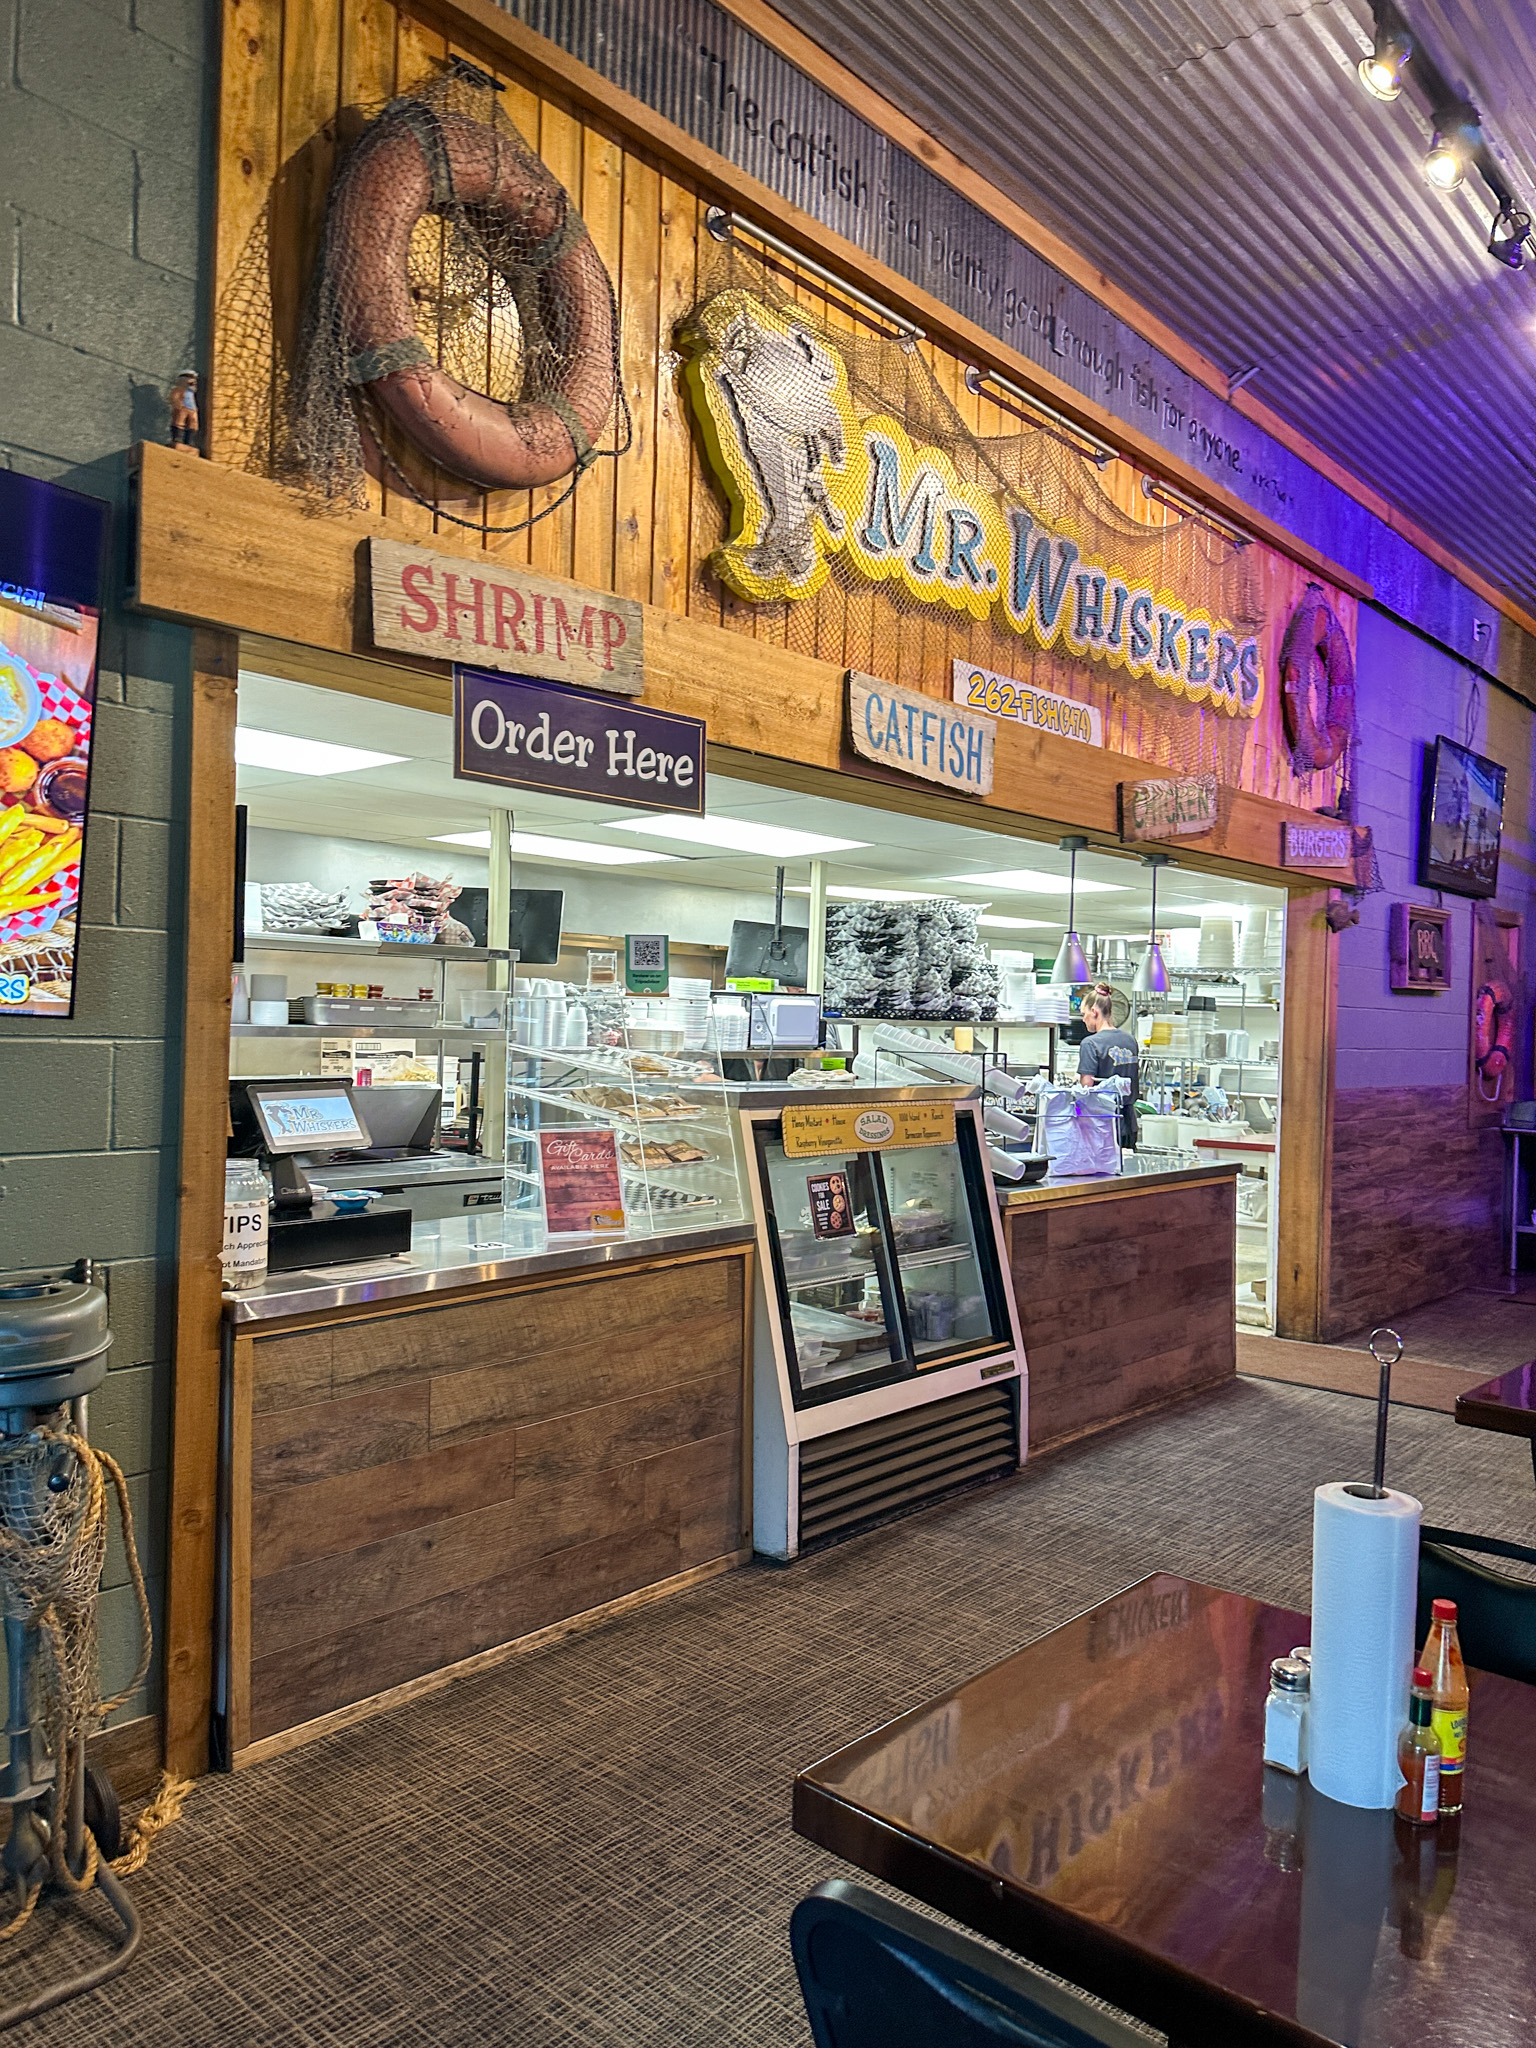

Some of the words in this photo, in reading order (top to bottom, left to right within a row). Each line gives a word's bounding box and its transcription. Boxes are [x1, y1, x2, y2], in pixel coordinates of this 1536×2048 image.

[769, 118, 868, 209] catfish
[905, 218, 921, 250] a
[1061, 324, 1124, 395] enough
[1130, 362, 1158, 415] fish
[1162, 396, 1185, 430] for
[862, 440, 998, 584] MR.
[1012, 512, 1260, 700] WHISKERS
[0, 581, 46, 611] cial
[400, 563, 627, 671] SHRIMP
[470, 699, 595, 769] Order
[605, 729, 695, 787] Here
[865, 692, 984, 785] CATFISH
[1133, 785, 1209, 829] CHICKEN
[1289, 828, 1346, 858] BURGERS
[1417, 929, 1439, 963] BBQ
[292, 1119, 357, 1132] WHISKERS
[860, 1114, 888, 1126] SALAD
[931, 1108, 944, 1120] Ranch
[859, 1127, 890, 1139] DRESSINGS
[546, 1139, 579, 1156] Gift
[568, 1148, 614, 1163] Cards
[811, 1181, 830, 1193] COOKIES
[816, 1199, 830, 1211] SALE
[224, 1213, 262, 1234] IPS
